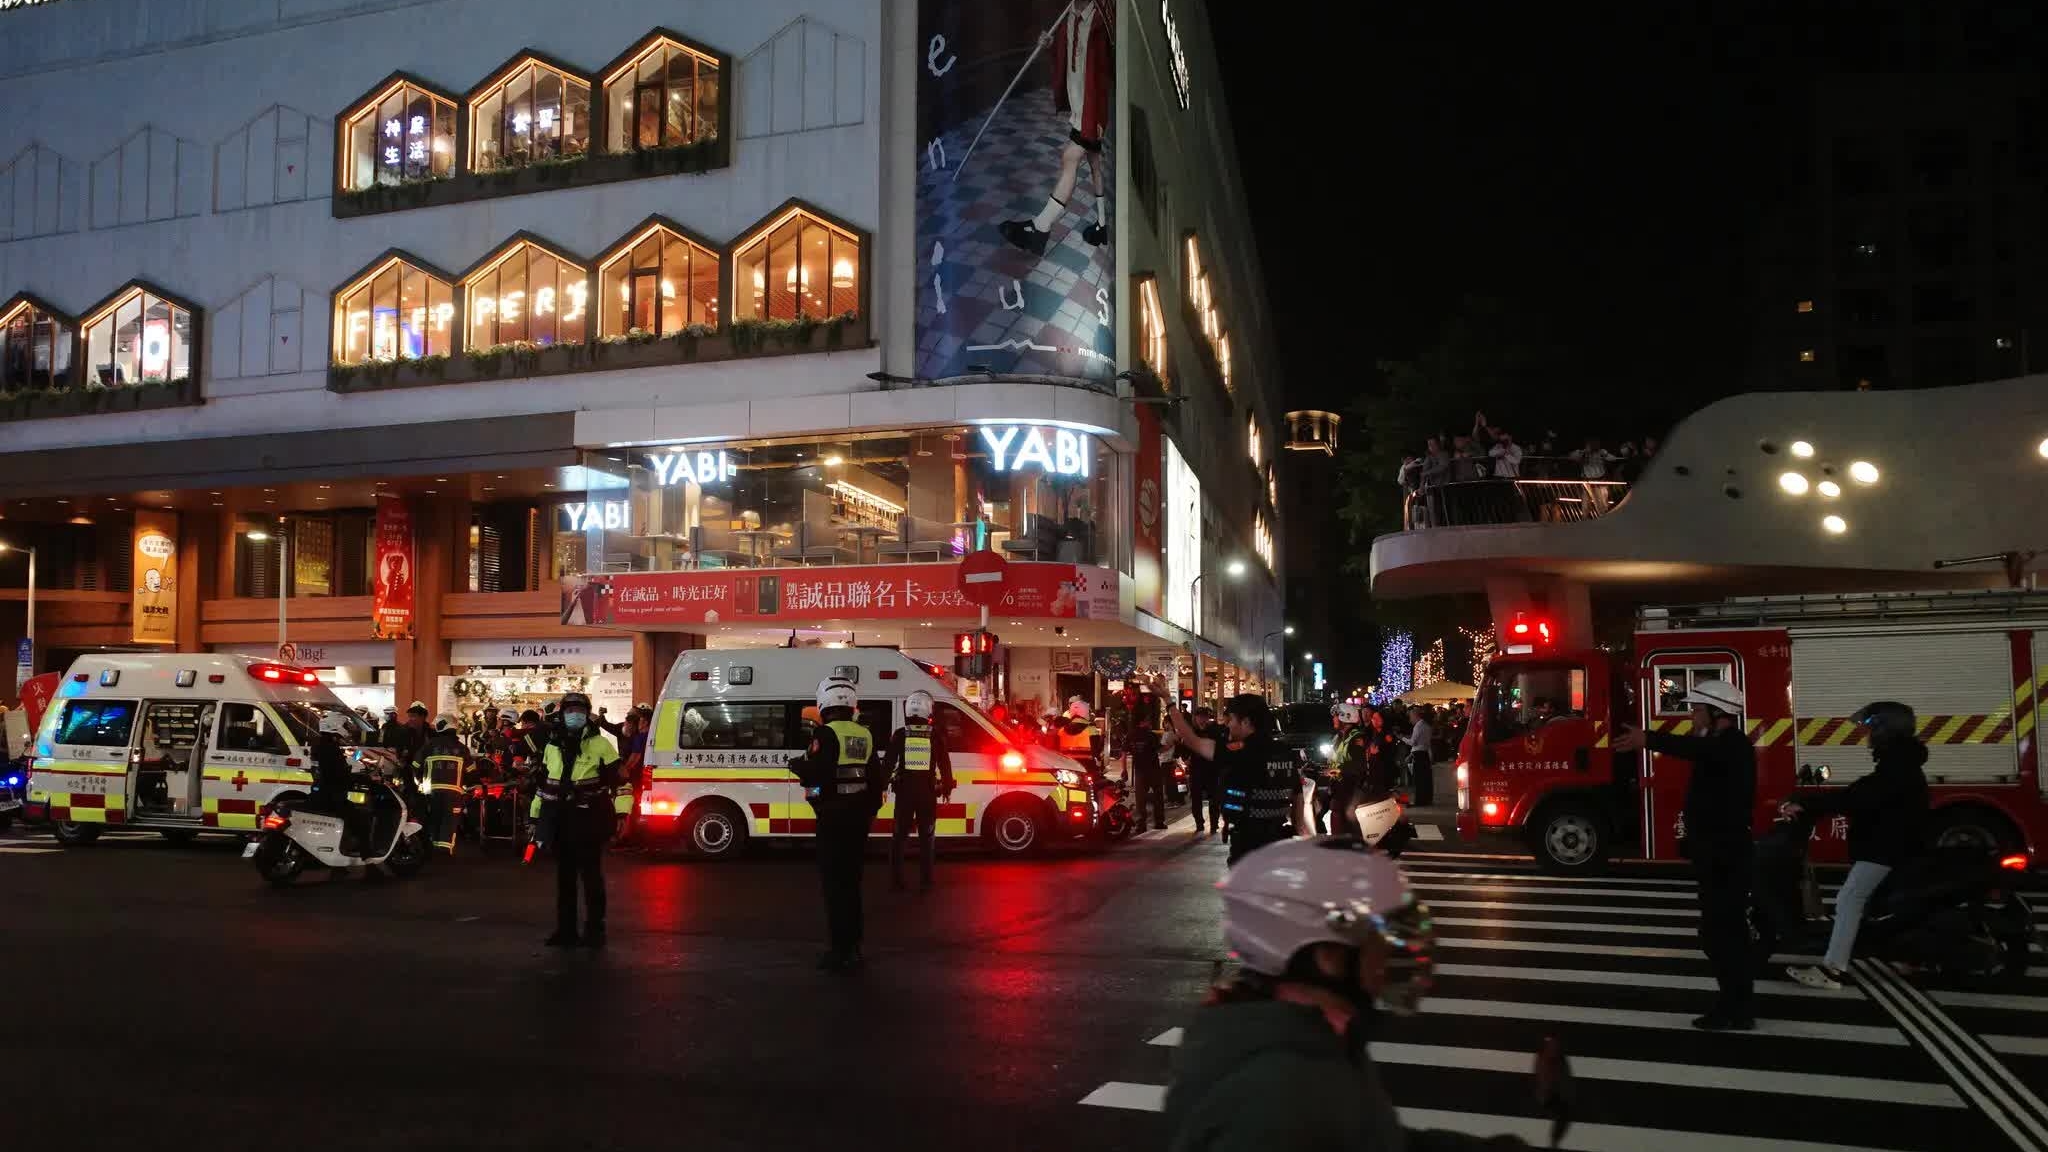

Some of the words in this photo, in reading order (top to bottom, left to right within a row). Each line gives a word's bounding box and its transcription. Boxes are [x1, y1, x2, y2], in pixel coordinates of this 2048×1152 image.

[384, 141, 424, 164] 生活
[979, 426, 1089, 477] YABI
[650, 452, 727, 485] YABI
[564, 502, 629, 530] YABI
[799, 579, 921, 609] 誠品聯名卡
[512, 645, 548, 657] HOLA
[1266, 760, 1293, 770] POLICE
